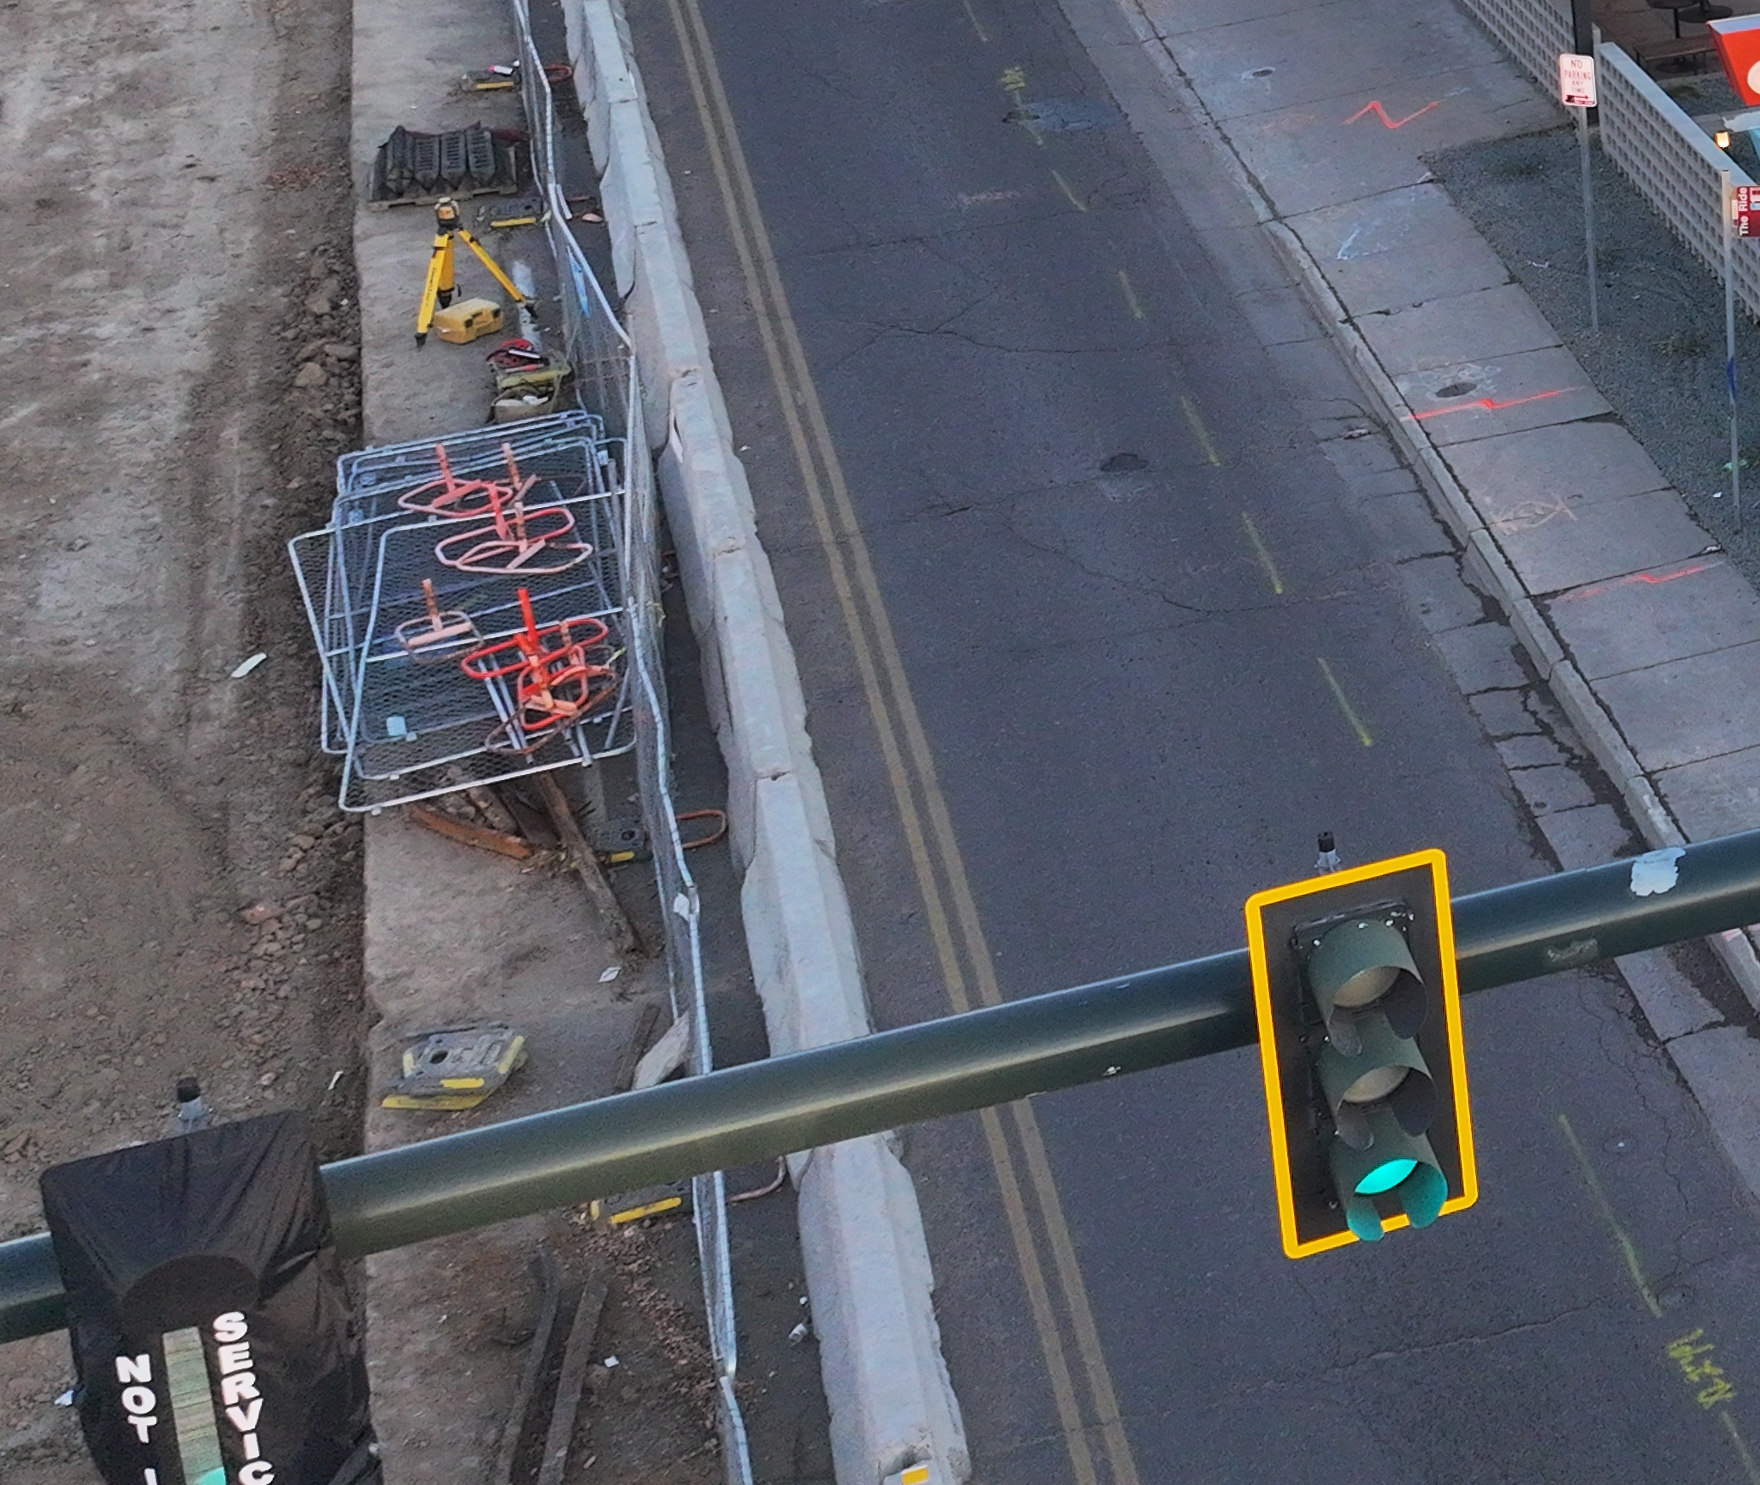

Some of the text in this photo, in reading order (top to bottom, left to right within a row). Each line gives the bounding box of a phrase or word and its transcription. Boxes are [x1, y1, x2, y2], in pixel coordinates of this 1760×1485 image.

[1564, 70, 1591, 80] PARKING
[1571, 59, 1582, 69] NO
[1738, 187, 1749, 236] The Ride
[115, 1353, 158, 1444] NOT
